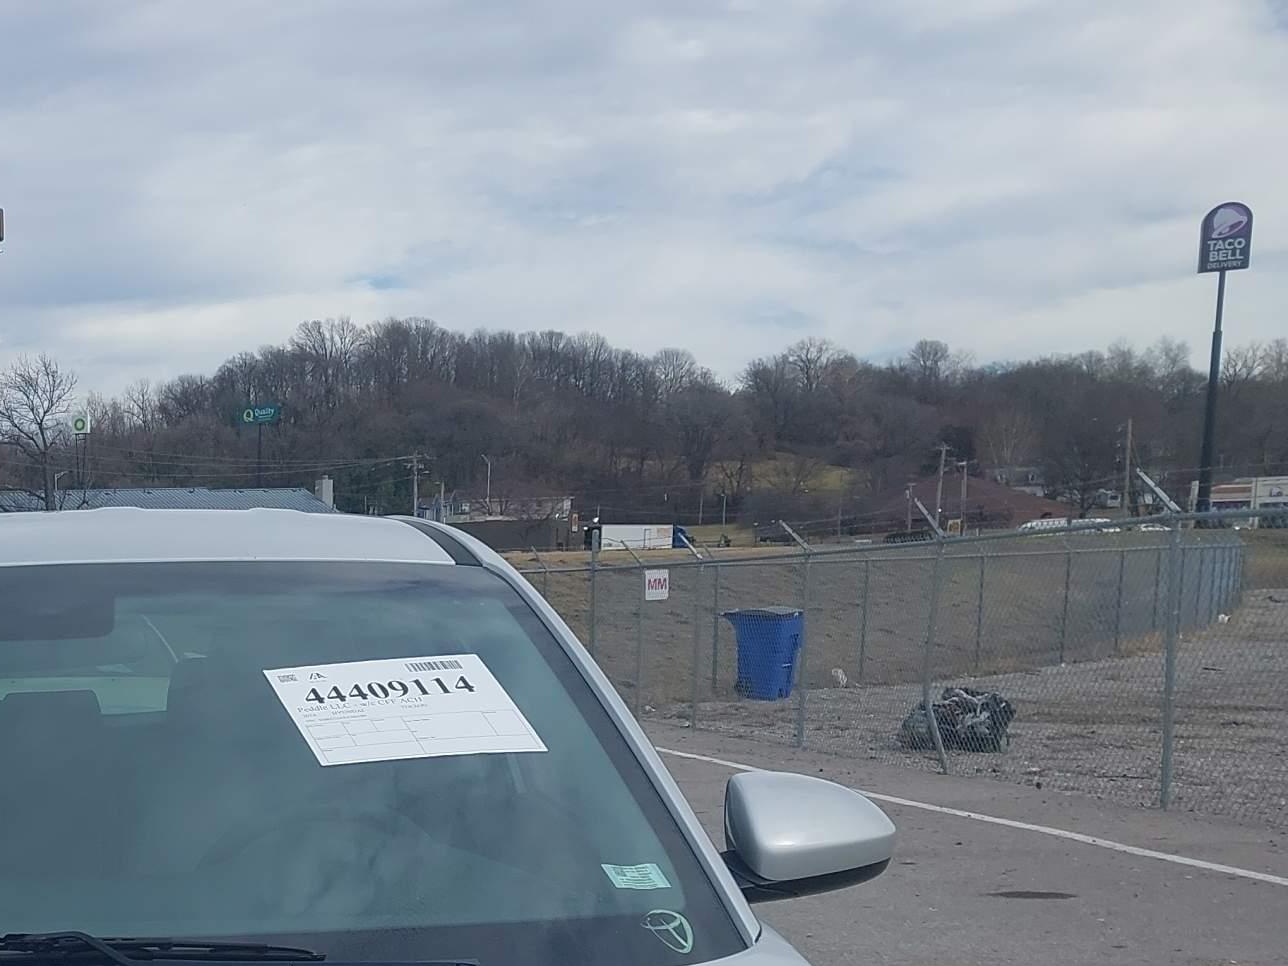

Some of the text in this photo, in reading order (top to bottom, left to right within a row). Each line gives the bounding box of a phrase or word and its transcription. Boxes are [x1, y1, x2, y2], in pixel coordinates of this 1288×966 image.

[1207, 238, 1246, 251] TACO
[1209, 249, 1244, 262] BELL
[647, 577, 667, 591] MM
[305, 675, 476, 704] 44409114
[297, 703, 329, 713] Peddle
[329, 702, 351, 710] LLC
